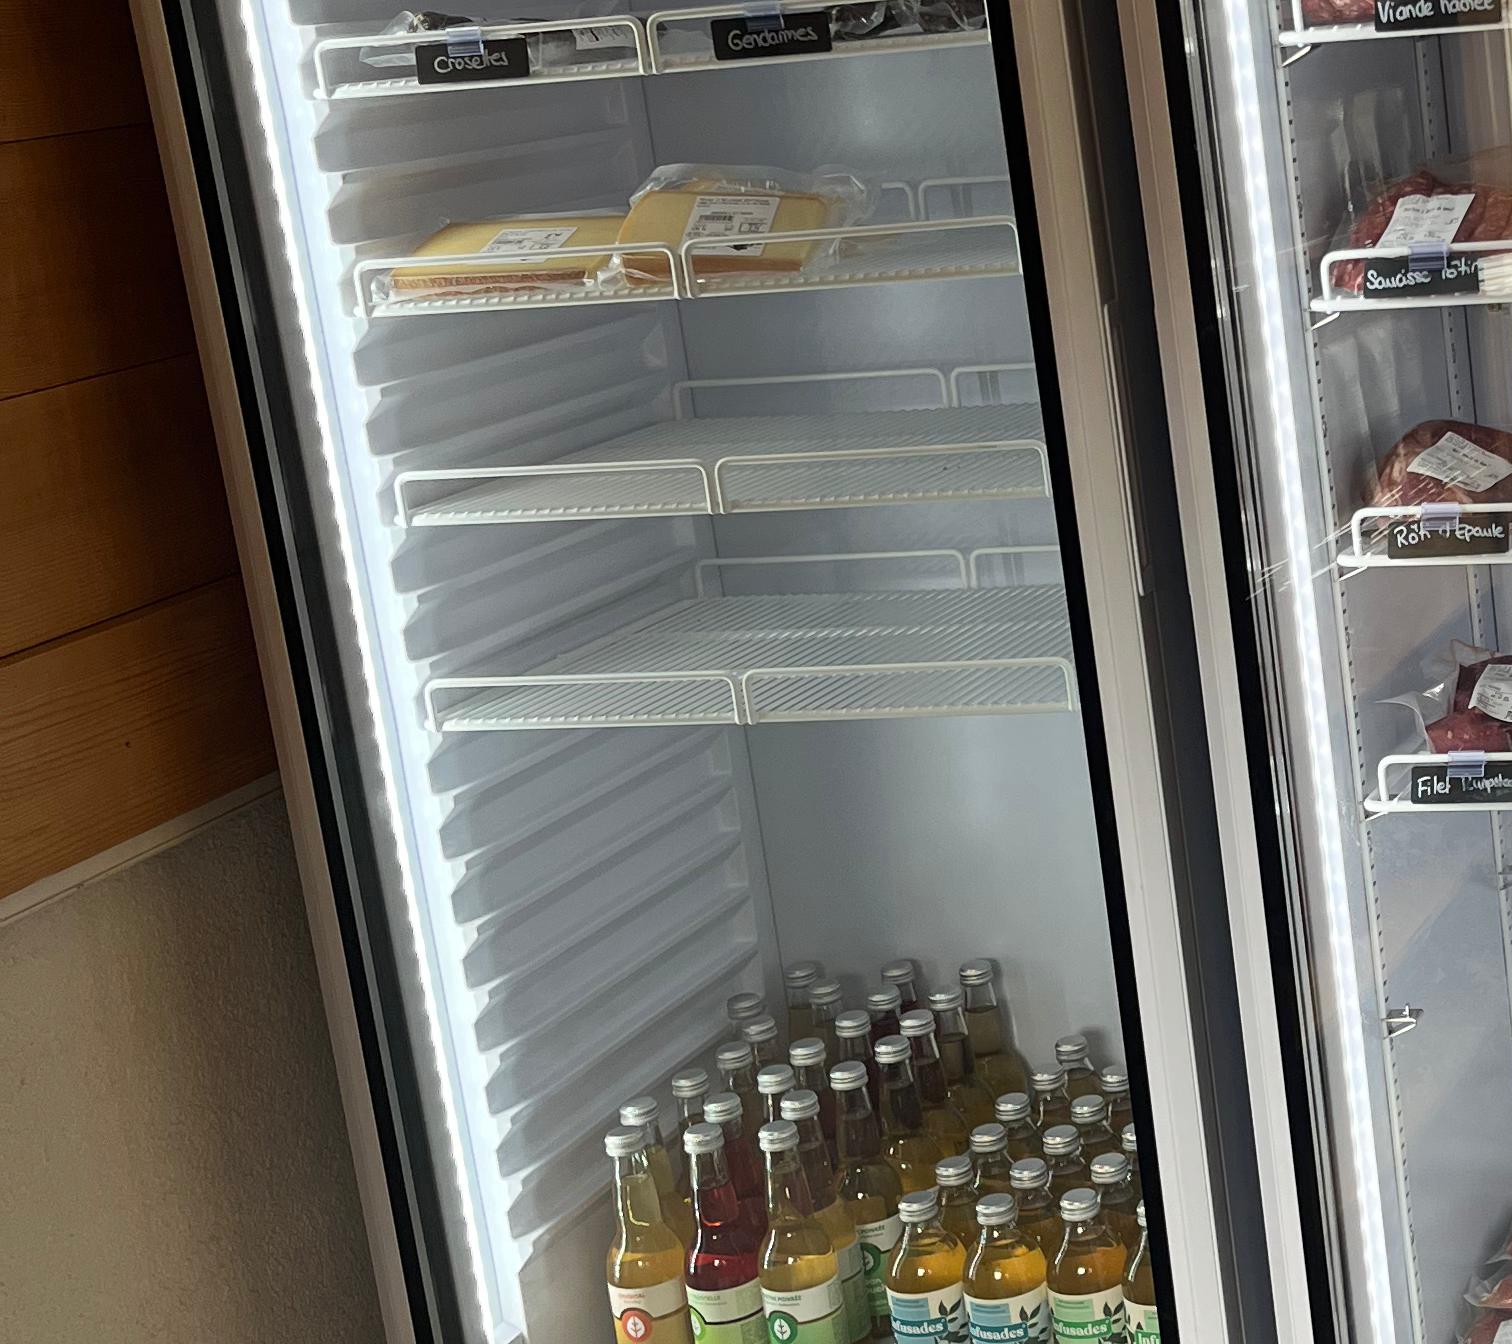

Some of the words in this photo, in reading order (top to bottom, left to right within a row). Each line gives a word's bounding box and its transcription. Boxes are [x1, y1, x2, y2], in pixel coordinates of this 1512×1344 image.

[1366, 268, 1431, 290] Saucisse
[1417, 775, 1451, 798] Filet
[892, 1320, 944, 1334] nfusades
[1053, 1322, 1107, 1336] nfusades
